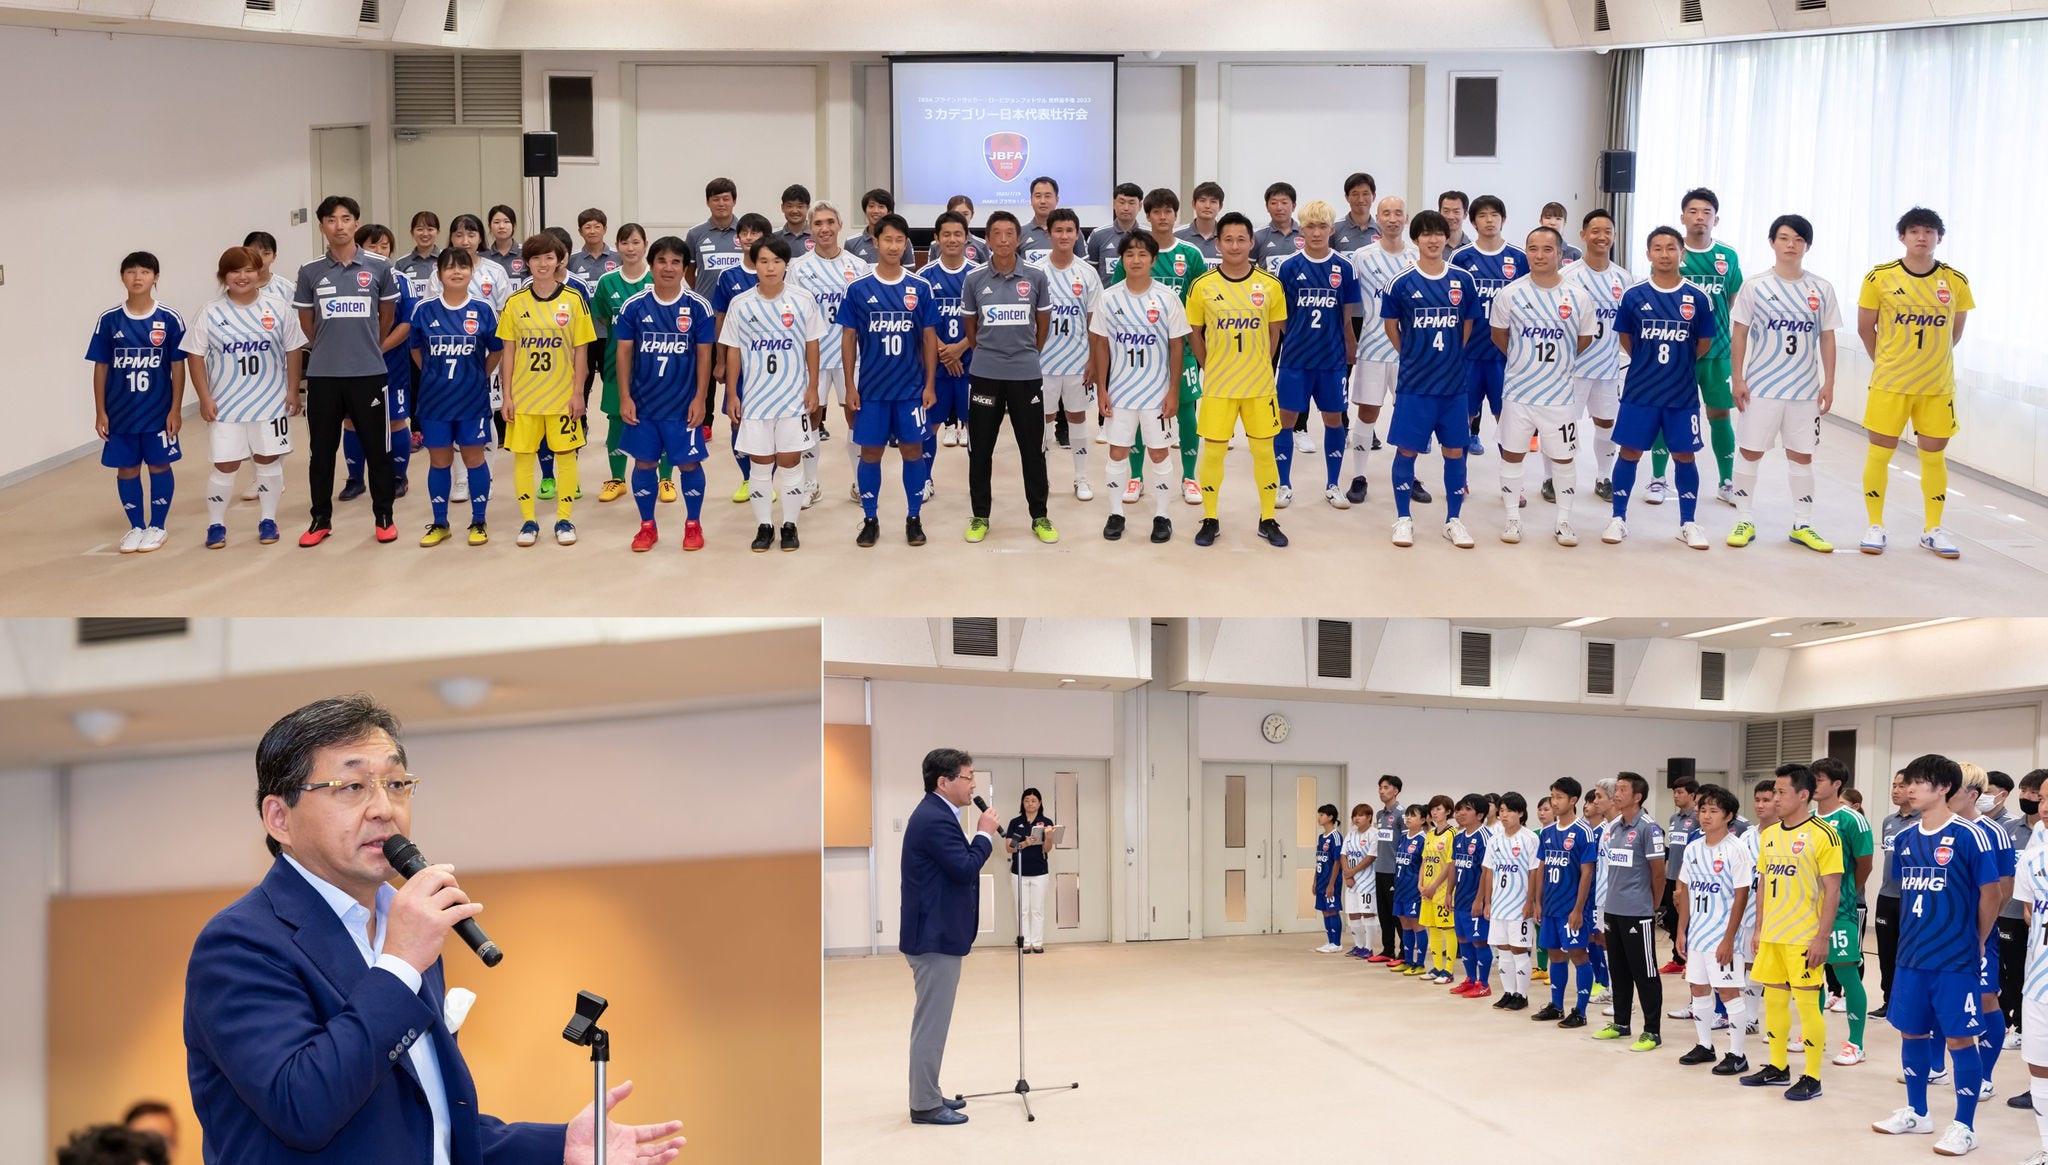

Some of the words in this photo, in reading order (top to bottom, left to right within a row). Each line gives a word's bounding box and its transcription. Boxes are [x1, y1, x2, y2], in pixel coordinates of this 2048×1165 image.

[989, 152, 1024, 160] JBFA
[326, 299, 366, 316] Santen
[1297, 296, 1336, 308] KPMG
[987, 307, 1026, 323] Santen
[1217, 317, 1260, 330] KPMG
[1311, 309, 1321, 328] 2
[1413, 315, 1458, 329] KPMG
[1894, 313, 1946, 327] KPMG
[868, 320, 912, 333] KPMG
[948, 318, 959, 338] 8
[1052, 318, 1069, 336] 14
[1521, 326, 1564, 340] KPMG
[1641, 327, 1689, 342] KPMG
[1767, 319, 1814, 333] KPMG
[222, 340, 271, 354] KPMG
[520, 336, 562, 348] KPMG
[640, 340, 687, 354] KPMG
[750, 338, 793, 351] KPMG
[881, 335, 902, 356] 10
[1116, 332, 1157, 346] KPMG
[1234, 332, 1242, 353] 1
[1432, 331, 1444, 351] 4
[1785, 335, 1797, 355] 3
[1914, 329, 1923, 350] 1
[430, 344, 474, 356] KPMG
[1127, 348, 1145, 368] 11
[1535, 342, 1556, 362] 12
[1657, 343, 1670, 364] 8
[113, 355, 161, 369] KPMG
[238, 355, 259, 377] 10
[445, 358, 457, 380] 7
[530, 351, 551, 372] 23
[657, 356, 669, 377] 7
[767, 354, 777, 374] 6
[126, 371, 149, 392] 16
[1183, 366, 1198, 387] 15
[1268, 398, 1276, 418] 1
[1947, 399, 1955, 419] 1
[270, 416, 288, 437] 10
[801, 414, 808, 432] 6
[1690, 414, 1699, 435] 8
[1814, 416, 1821, 436] 3
[1558, 422, 1576, 443] 12
[1397, 866, 1402, 877] 7
[1425, 864, 1434, 877] 23
[1457, 869, 1463, 882] 7
[1548, 868, 1560, 884] 10
[1500, 874, 1507, 889] 6
[1770, 878, 1777, 898] 1
[1901, 876, 1944, 892] KPMG
[1361, 893, 1371, 904] 10
[1695, 894, 1709, 914] 11
[1912, 894, 1923, 918] 4
[1471, 917, 1479, 931] 7
[1521, 921, 1528, 935] 6
[1830, 930, 1849, 949] 15
[1964, 992, 1977, 1016] 4
